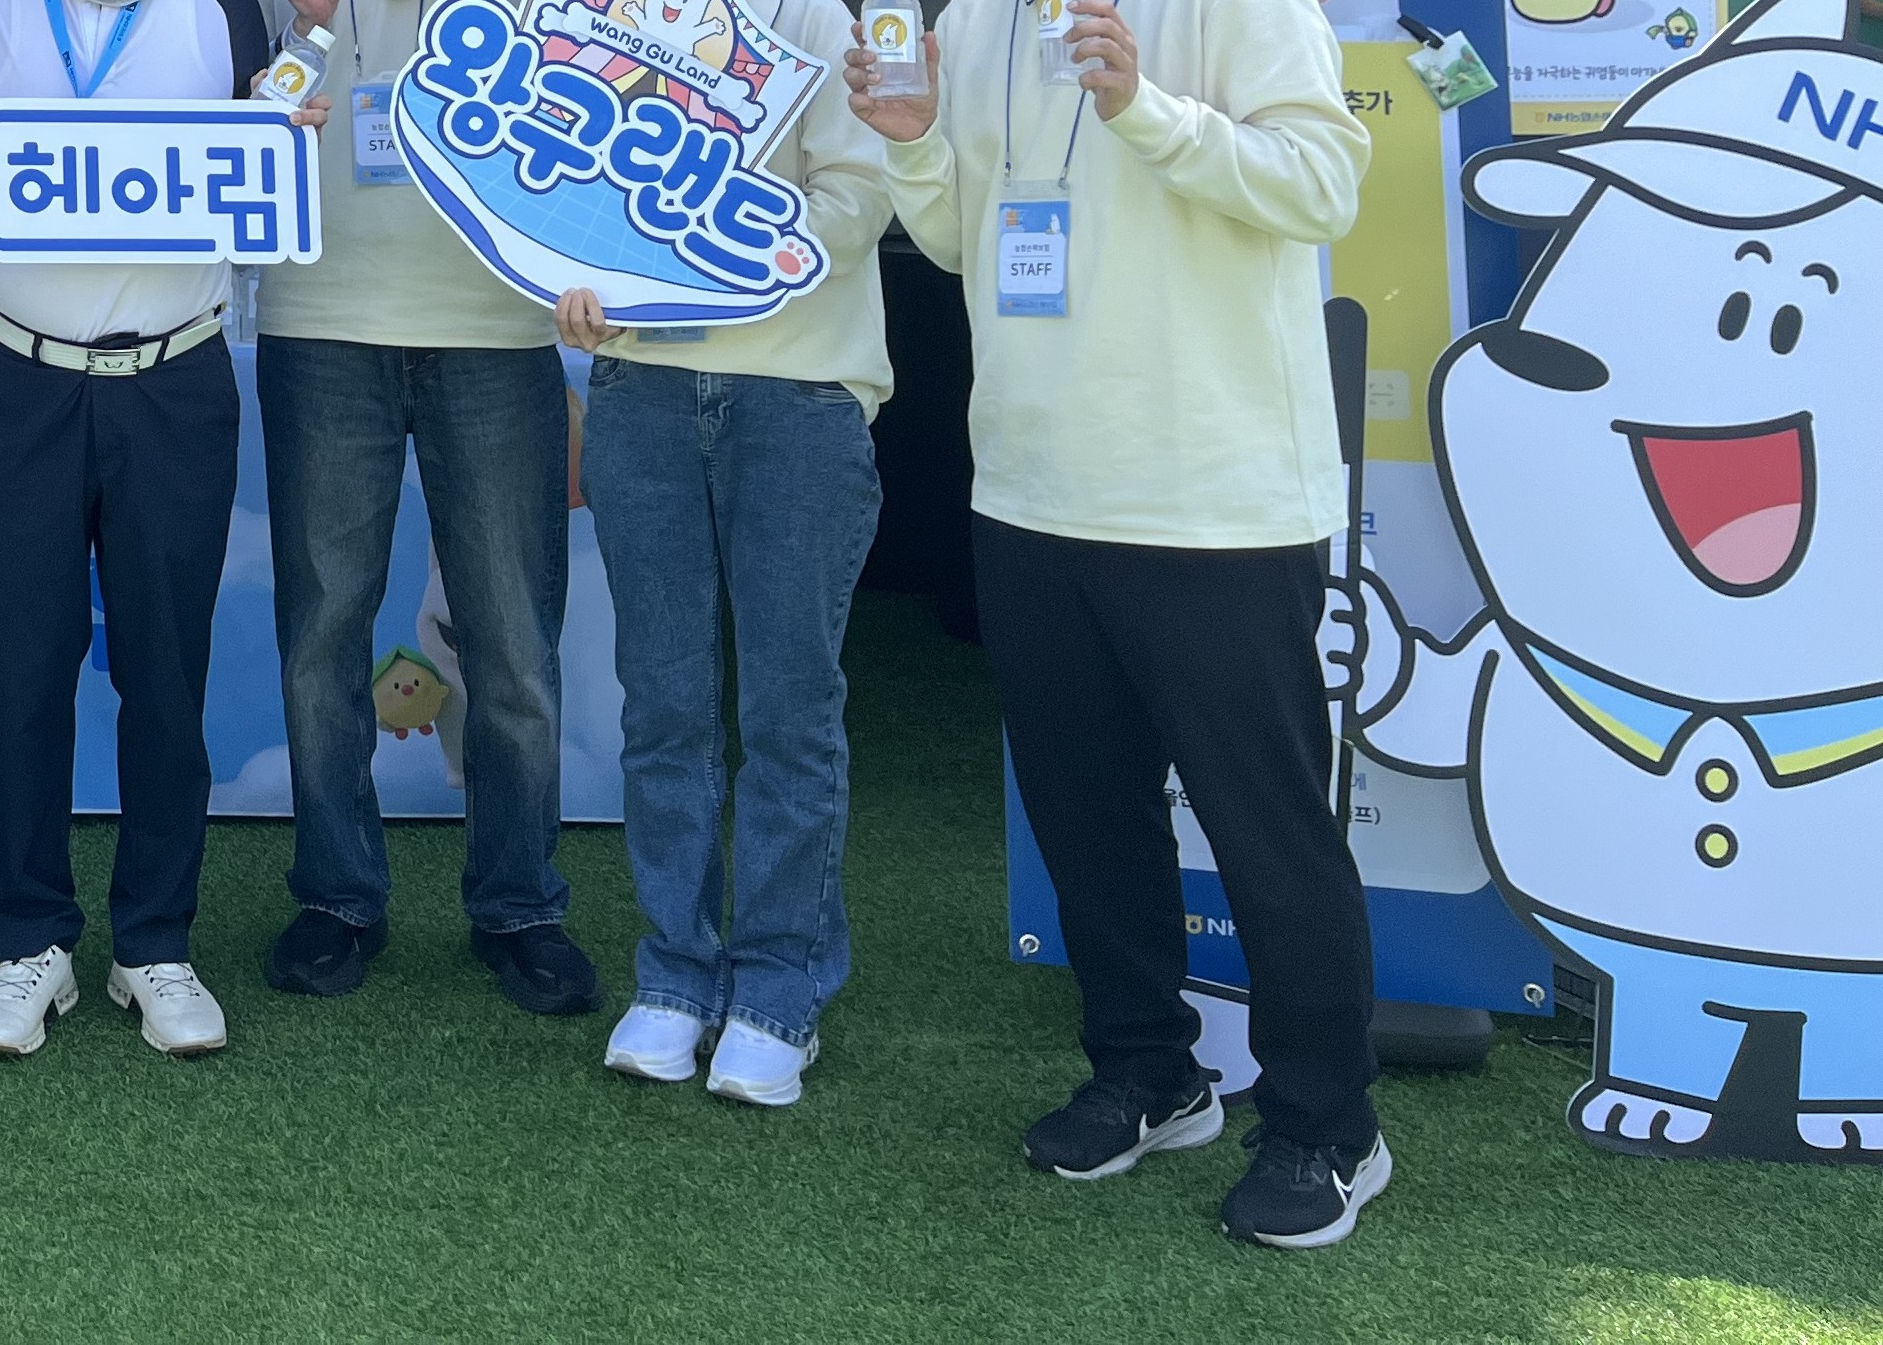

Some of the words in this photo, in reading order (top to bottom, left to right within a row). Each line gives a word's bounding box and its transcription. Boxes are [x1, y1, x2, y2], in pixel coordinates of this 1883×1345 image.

[590, 16, 644, 55] Wang
[674, 56, 722, 89] Land
[1343, 89, 1393, 115] 추가
[368, 139, 396, 152] STA
[421, 1, 791, 284] 왕구랜드
[6, 141, 278, 252] 헤아림
[1010, 262, 1053, 277] STAFF
